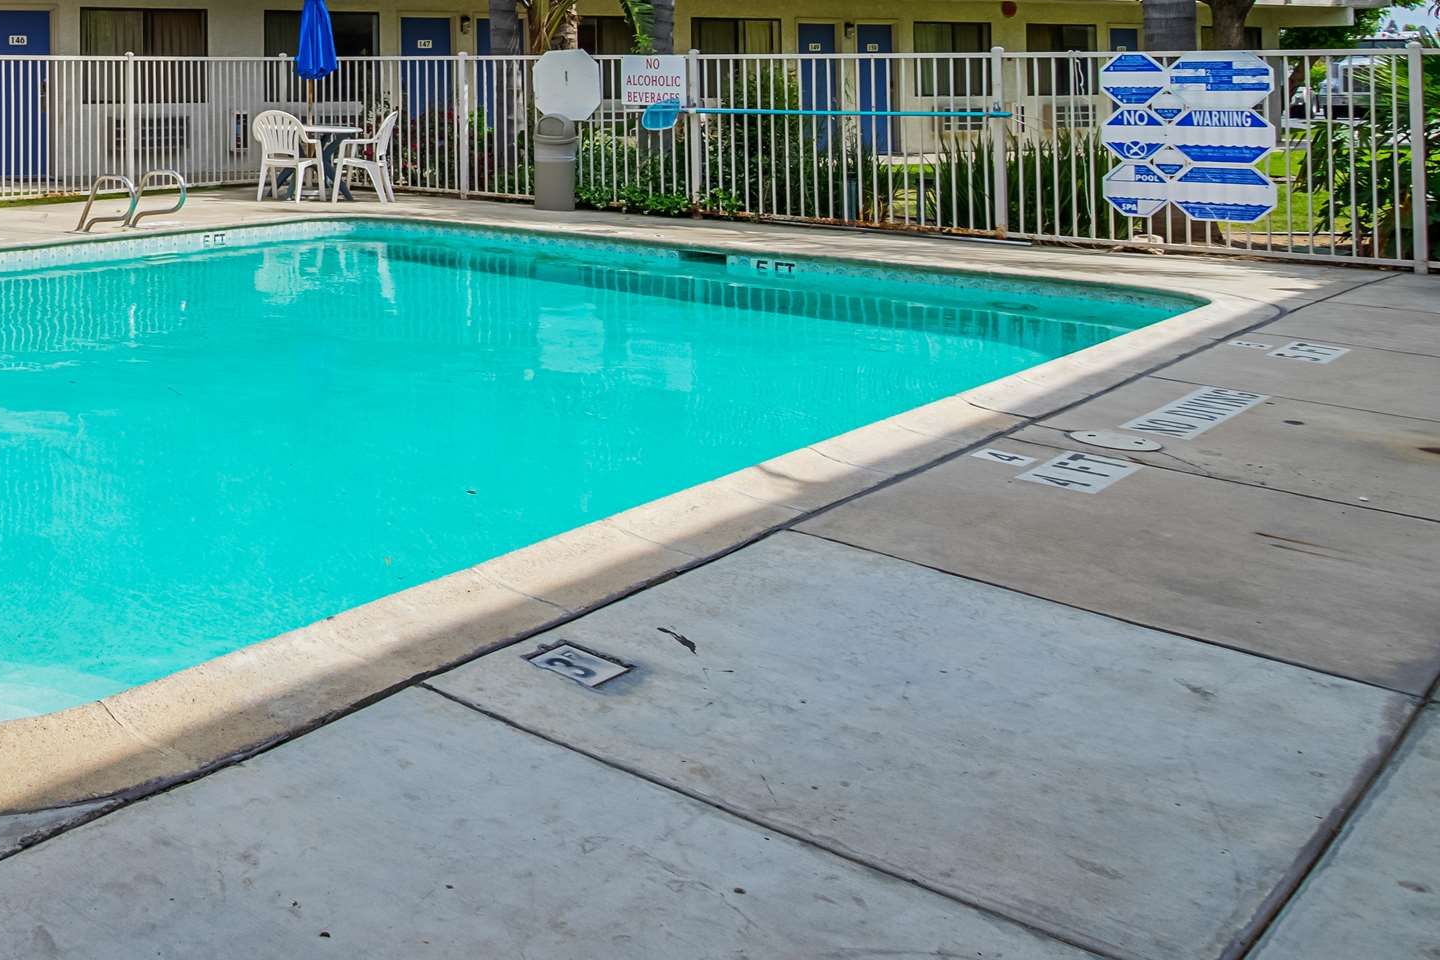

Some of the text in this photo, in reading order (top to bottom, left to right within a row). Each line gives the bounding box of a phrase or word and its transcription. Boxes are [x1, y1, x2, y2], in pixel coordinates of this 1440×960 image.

[11, 36, 25, 44] 146
[419, 40, 431, 48] 147
[646, 58, 660, 70] NO
[625, 75, 681, 87] ALCOHOLIC
[627, 91, 680, 104] BEVERAGES
[1123, 110, 1148, 126] NO
[1191, 111, 1252, 128] WARNING
[1135, 174, 1160, 183] POOL
[1121, 203, 1137, 211] SPA
[1130, 389, 1260, 438] NO DIVING
[545, 657, 598, 679] 3
